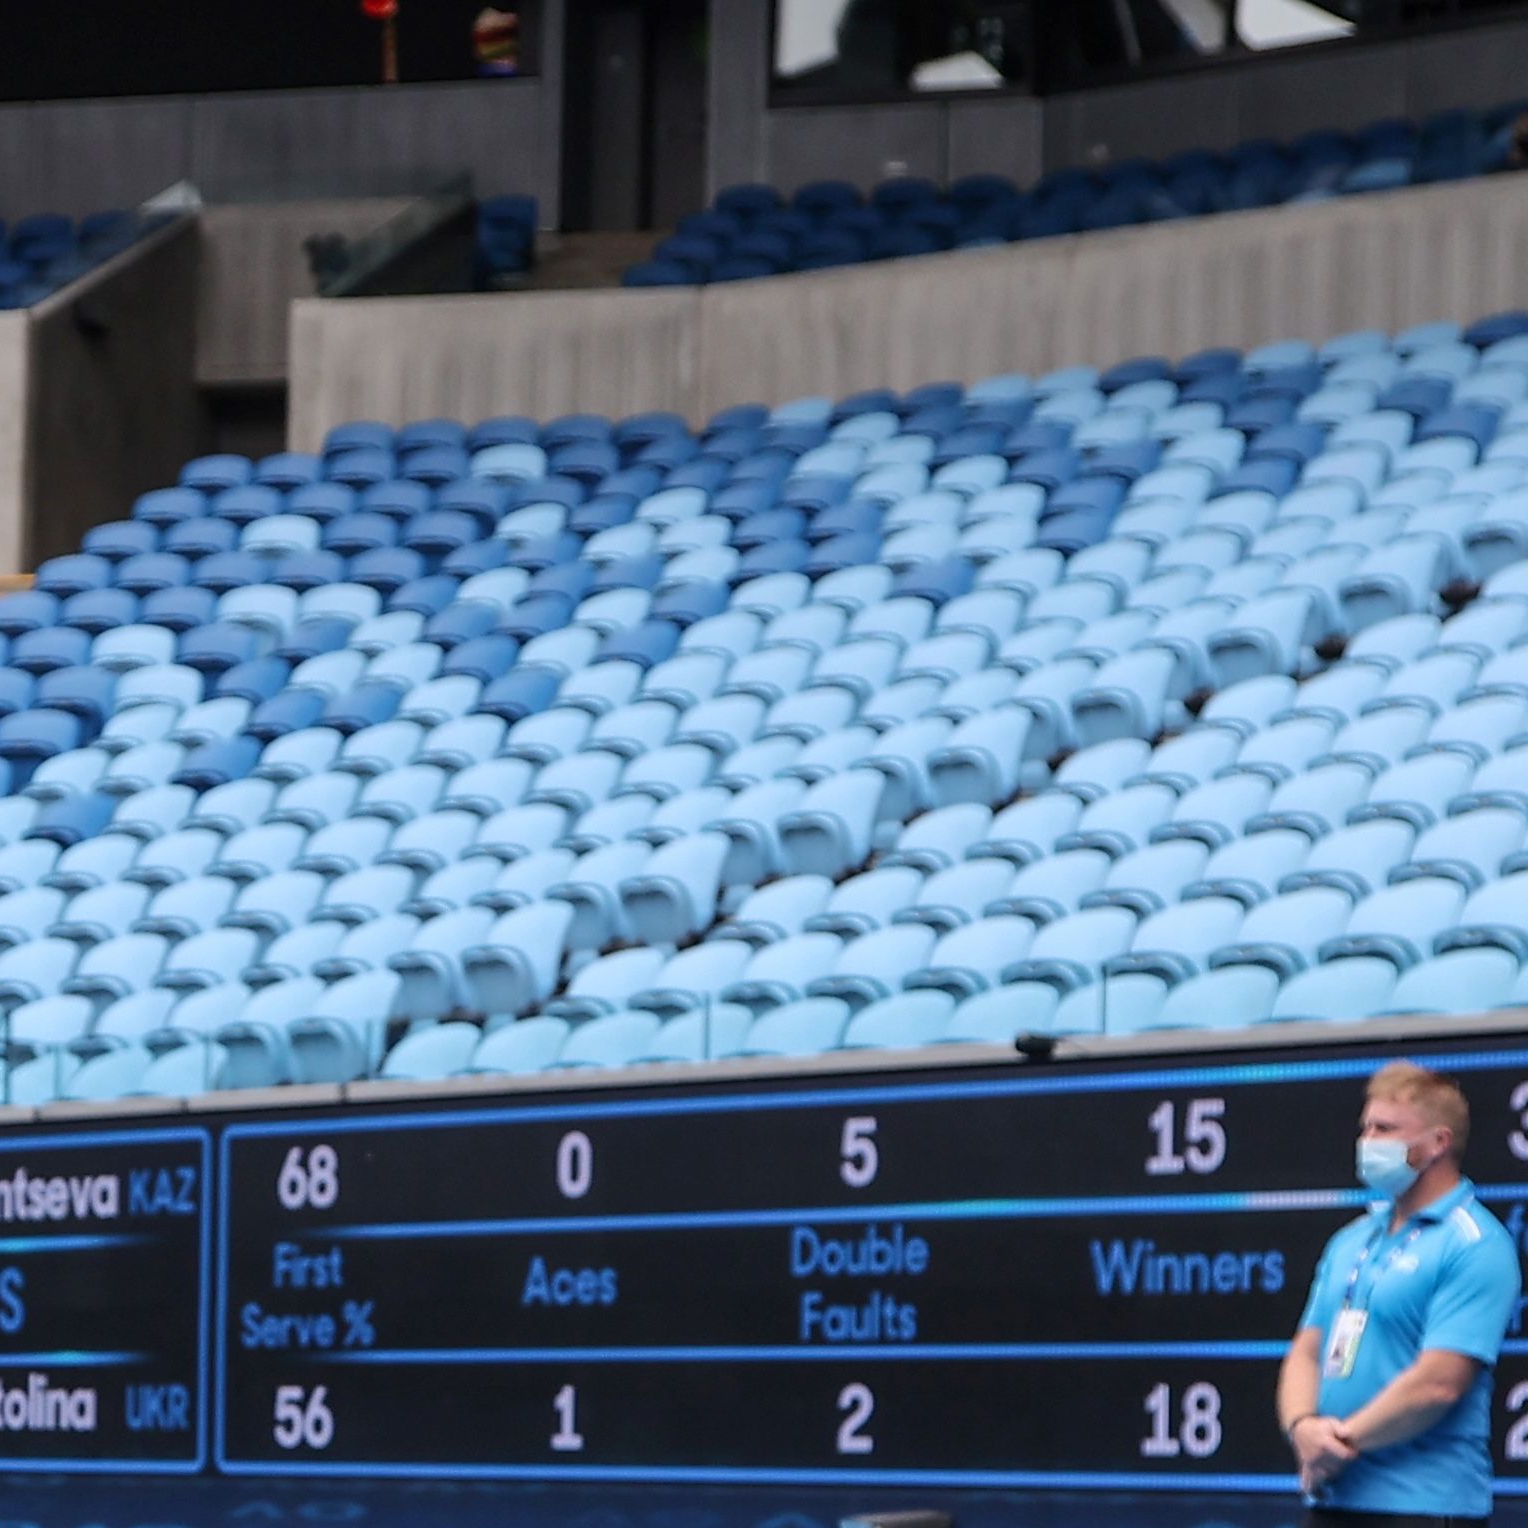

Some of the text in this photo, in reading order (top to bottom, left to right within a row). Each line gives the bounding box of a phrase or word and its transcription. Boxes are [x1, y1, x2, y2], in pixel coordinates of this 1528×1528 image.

[556, 1130, 594, 1199] 0
[840, 1115, 879, 1188] 5
[1144, 1098, 1227, 1175] 15
[128, 1166, 198, 1215] KAZ
[277, 1144, 339, 1210] 68
[272, 1242, 345, 1289] First
[521, 1256, 619, 1306] Aces
[790, 1223, 931, 1278] Double
[1089, 1238, 1286, 1296] Winners
[240, 1300, 376, 1350] Serve %
[799, 1291, 918, 1343] Faults
[124, 1383, 190, 1431] UKR
[273, 1384, 334, 1449] 56
[549, 1384, 584, 1451] 1
[836, 1381, 875, 1454] 2
[1140, 1381, 1223, 1457] 18
